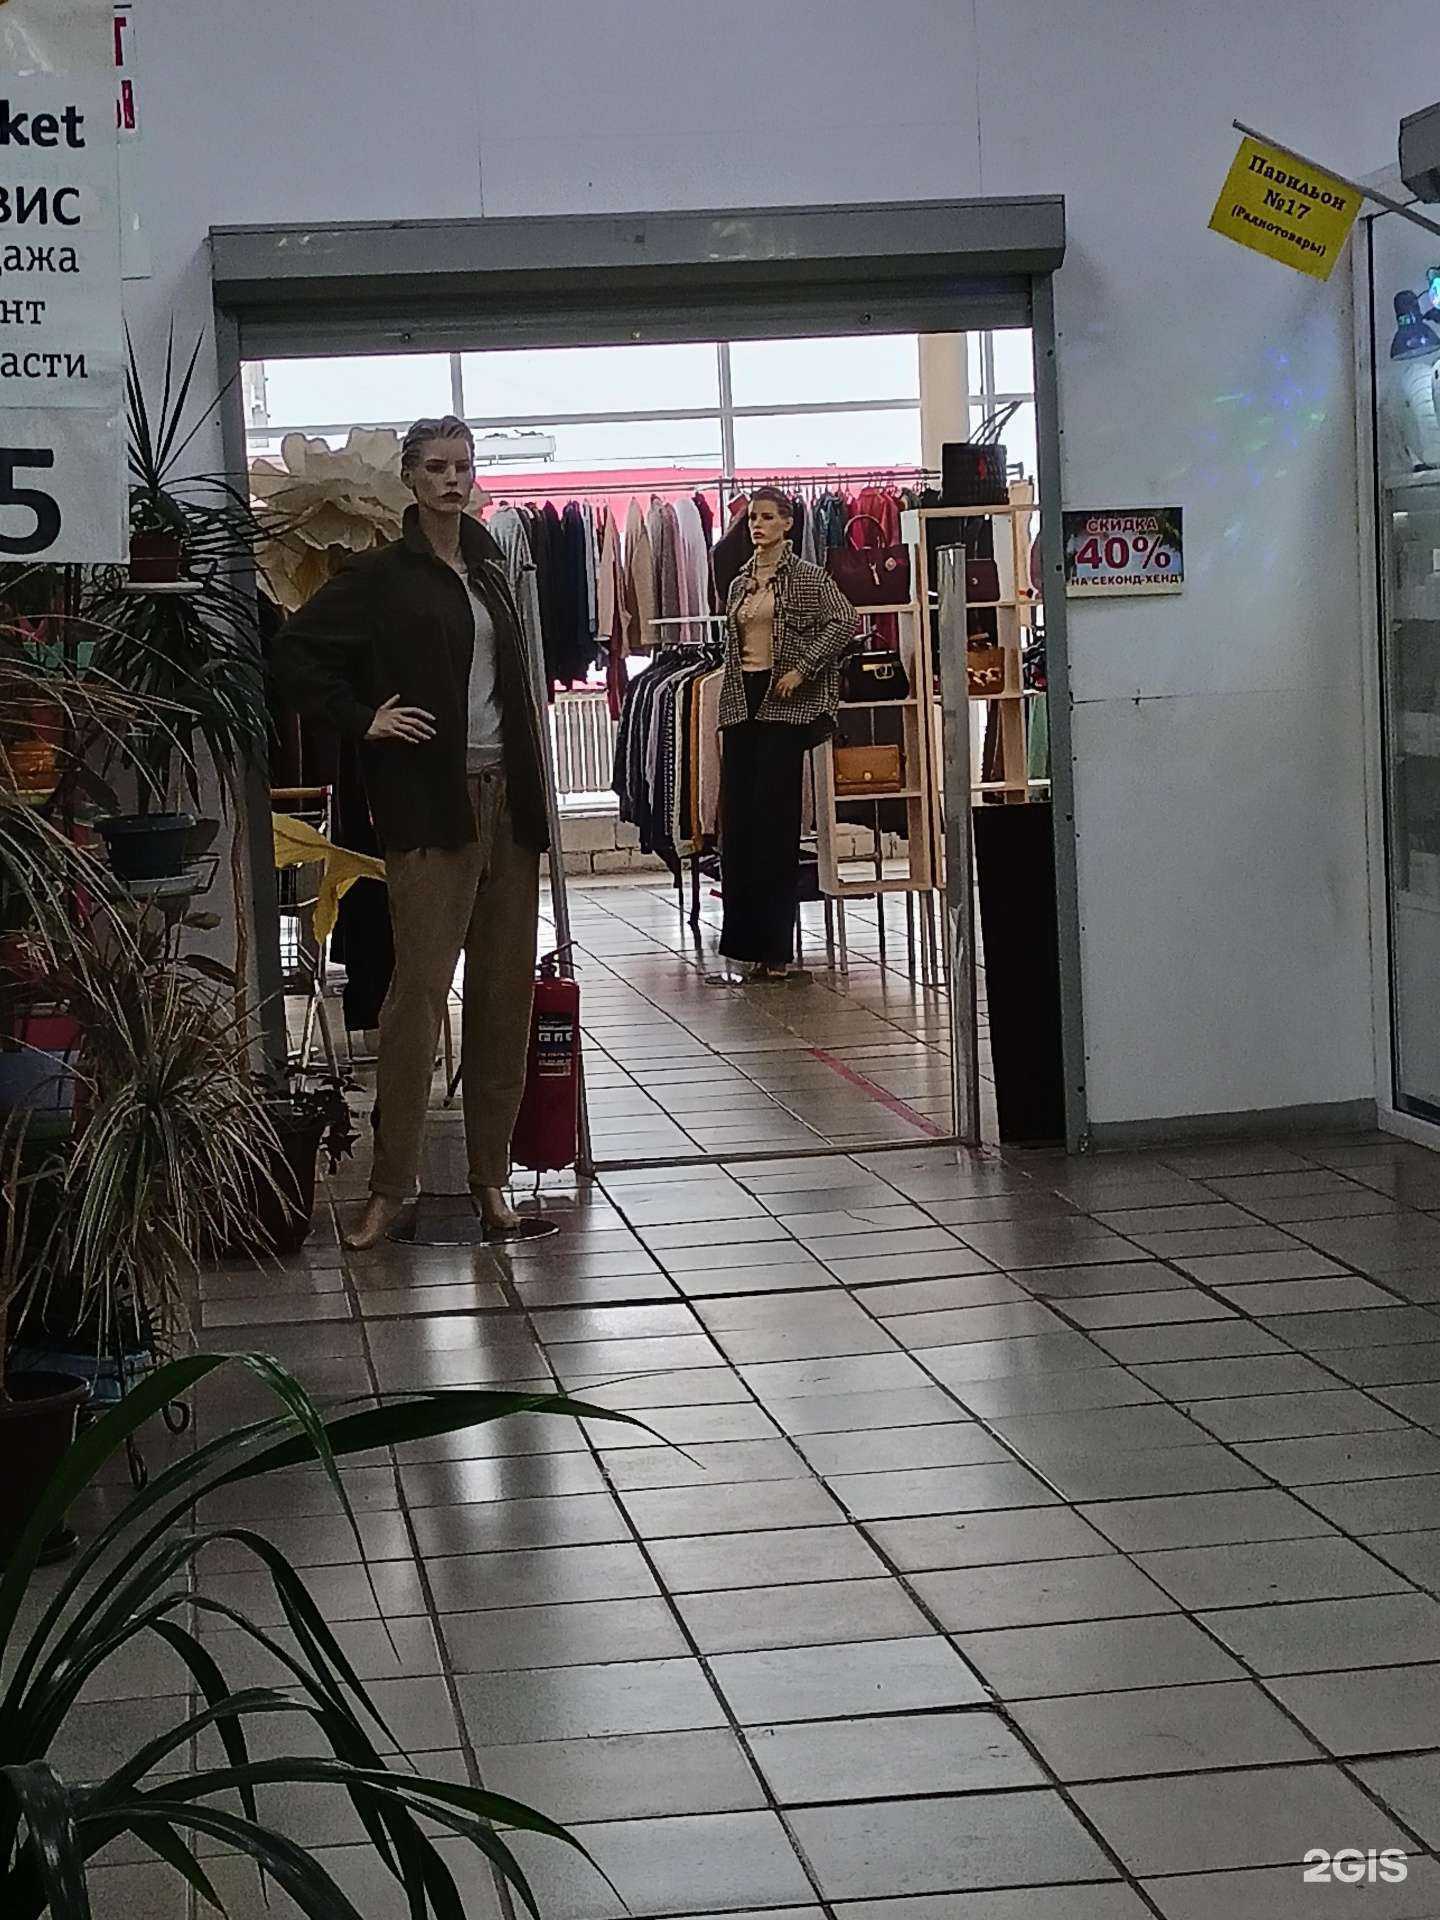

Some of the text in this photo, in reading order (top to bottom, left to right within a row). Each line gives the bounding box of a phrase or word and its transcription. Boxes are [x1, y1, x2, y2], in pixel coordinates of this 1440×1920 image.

[0, 99, 86, 148] ket
[1263, 189, 1311, 220] №17
[0, 245, 80, 276] ажа
[0, 352, 88, 378] асти
[0, 446, 62, 555] 5
[1087, 516, 1158, 533] СКИДКА
[1076, 534, 1172, 570] 40%
[1071, 574, 1180, 586] НА СЕКОНД-ХЕНД
